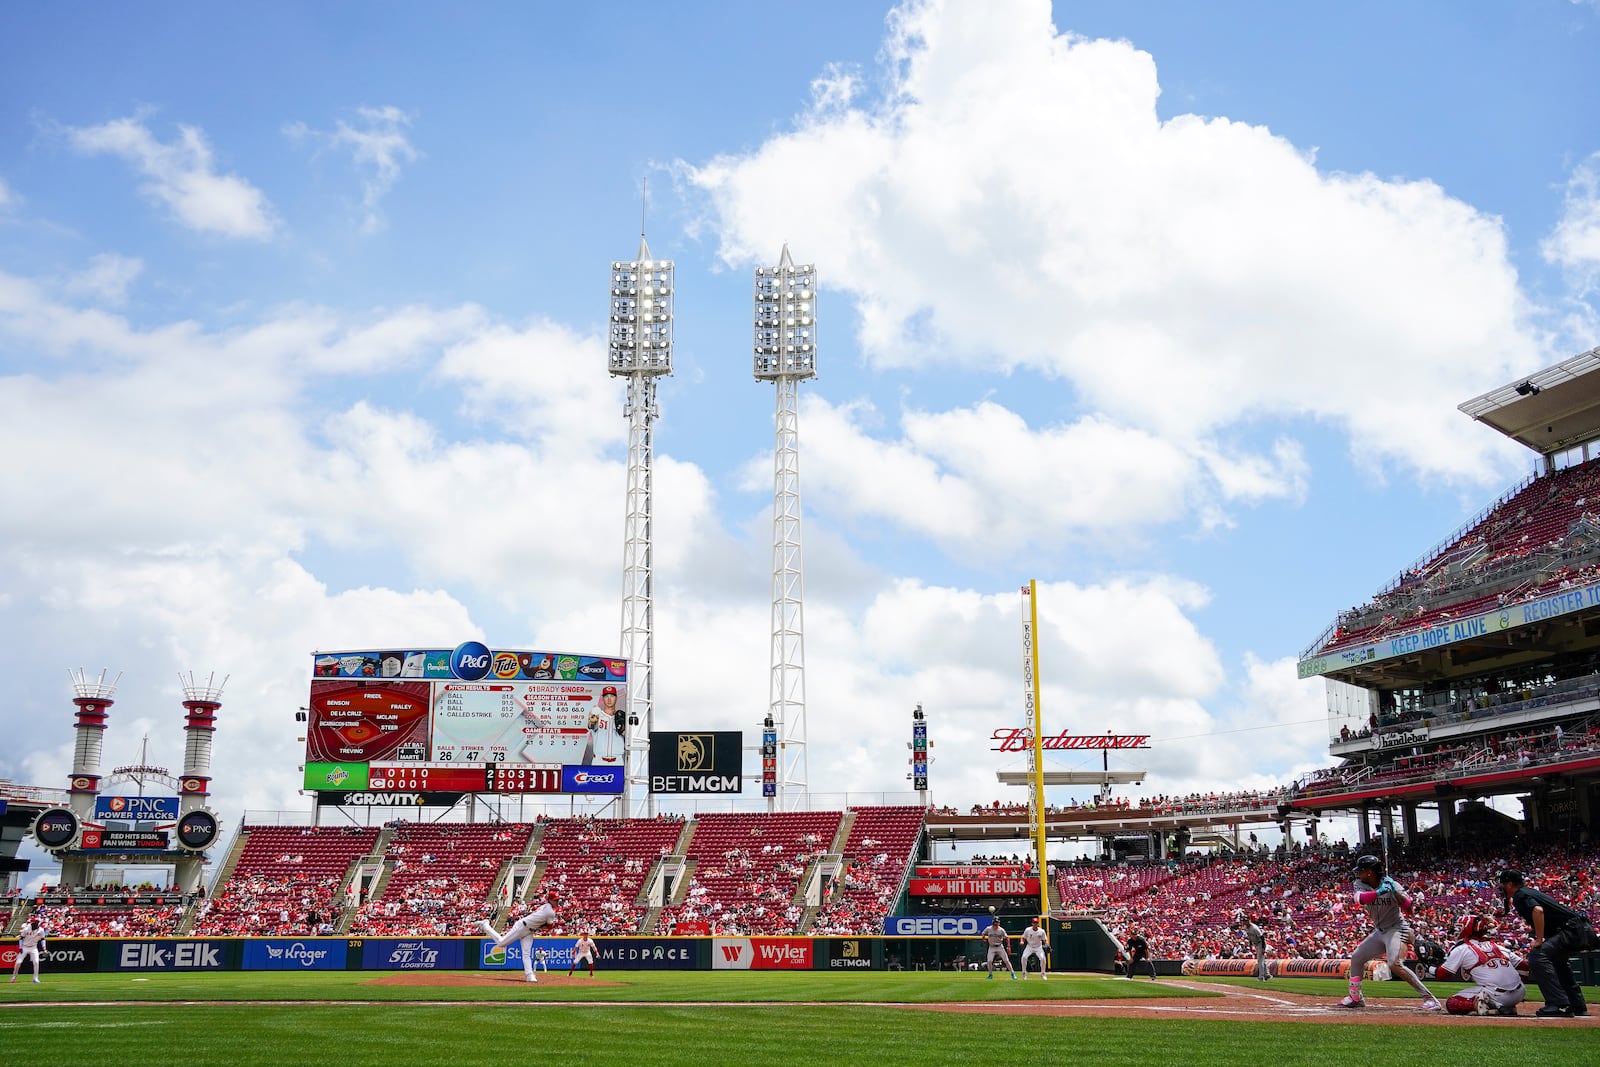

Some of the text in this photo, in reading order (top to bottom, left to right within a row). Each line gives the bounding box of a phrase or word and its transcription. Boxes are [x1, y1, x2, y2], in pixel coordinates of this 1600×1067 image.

[1523, 591, 1583, 623] REGISTER
[1391, 617, 1487, 655] KEEP HOPE ALIVE
[460, 654, 488, 669] P&G
[495, 658, 517, 674] Tide
[599, 719, 608, 729] 51
[1381, 731, 1428, 748] handlebar
[439, 751, 505, 762] 26 47 73
[113, 764, 168, 776] CINCINNATI
[388, 769, 395, 778] 0
[421, 769, 428, 778] 0
[487, 769, 494, 779] 2
[498, 770, 505, 779] 5
[508, 769, 515, 779] 0
[518, 769, 525, 779] 3
[387, 779, 394, 789] 0
[398, 779, 406, 789] 0
[409, 779, 417, 789] 0
[487, 780, 493, 790] 1
[497, 780, 505, 790] 2
[507, 780, 515, 790] 0
[517, 780, 525, 790] 4
[529, 771, 558, 789] 3 1 1
[575, 773, 615, 783] Crest
[652, 775, 739, 791] BETMGM
[127, 798, 165, 812] PNC
[51, 823, 71, 832] PNC
[192, 825, 212, 834] PNC
[947, 880, 1026, 893] HIT THE BUDS
[896, 918, 978, 935] GEICO
[1061, 922, 1072, 930] 325
[348, 940, 362, 948] 370
[120, 942, 219, 967] Elk+Elk
[285, 942, 327, 966] Kroger
[507, 947, 521, 959] St.
[602, 946, 690, 960] MEDPACE
[760, 945, 807, 962] Wyler
[830, 958, 871, 968] BETMGM
[1202, 961, 1228, 972] GORILLA
[1286, 960, 1340, 973] GORILLA TAPE
